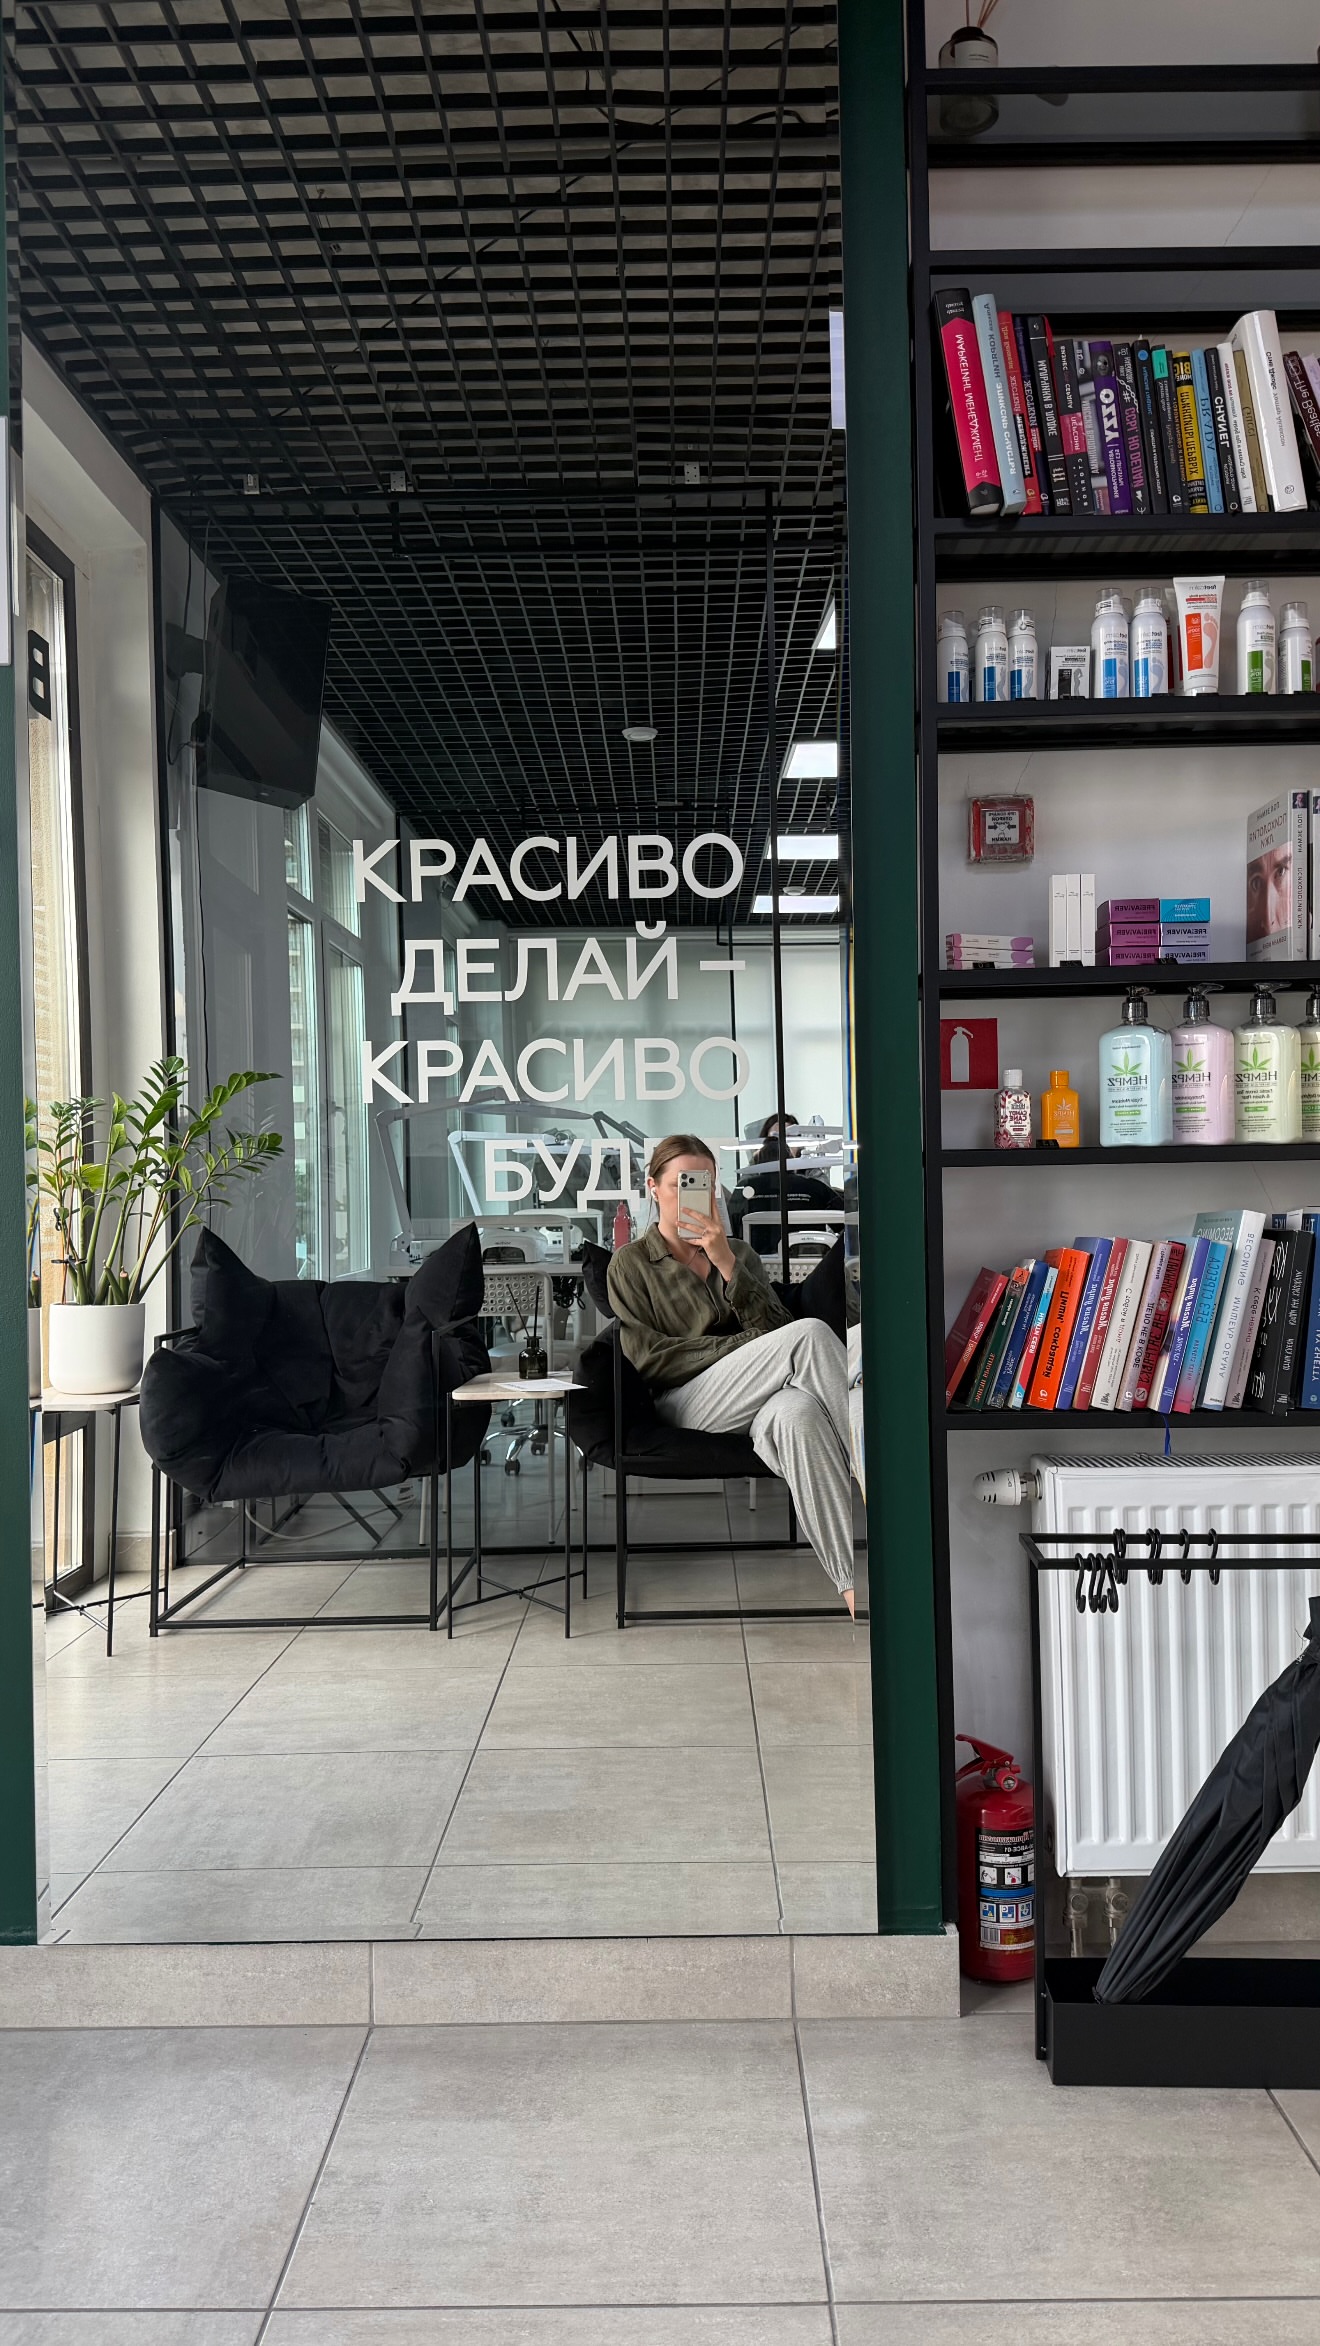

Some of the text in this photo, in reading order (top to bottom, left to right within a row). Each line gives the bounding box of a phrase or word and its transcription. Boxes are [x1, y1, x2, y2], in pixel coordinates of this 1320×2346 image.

[353, 833, 744, 902] КРАСИВО
[391, 921, 678, 1016] ДЕЛАЙ
[361, 1036, 750, 1105] КРАСИВО
